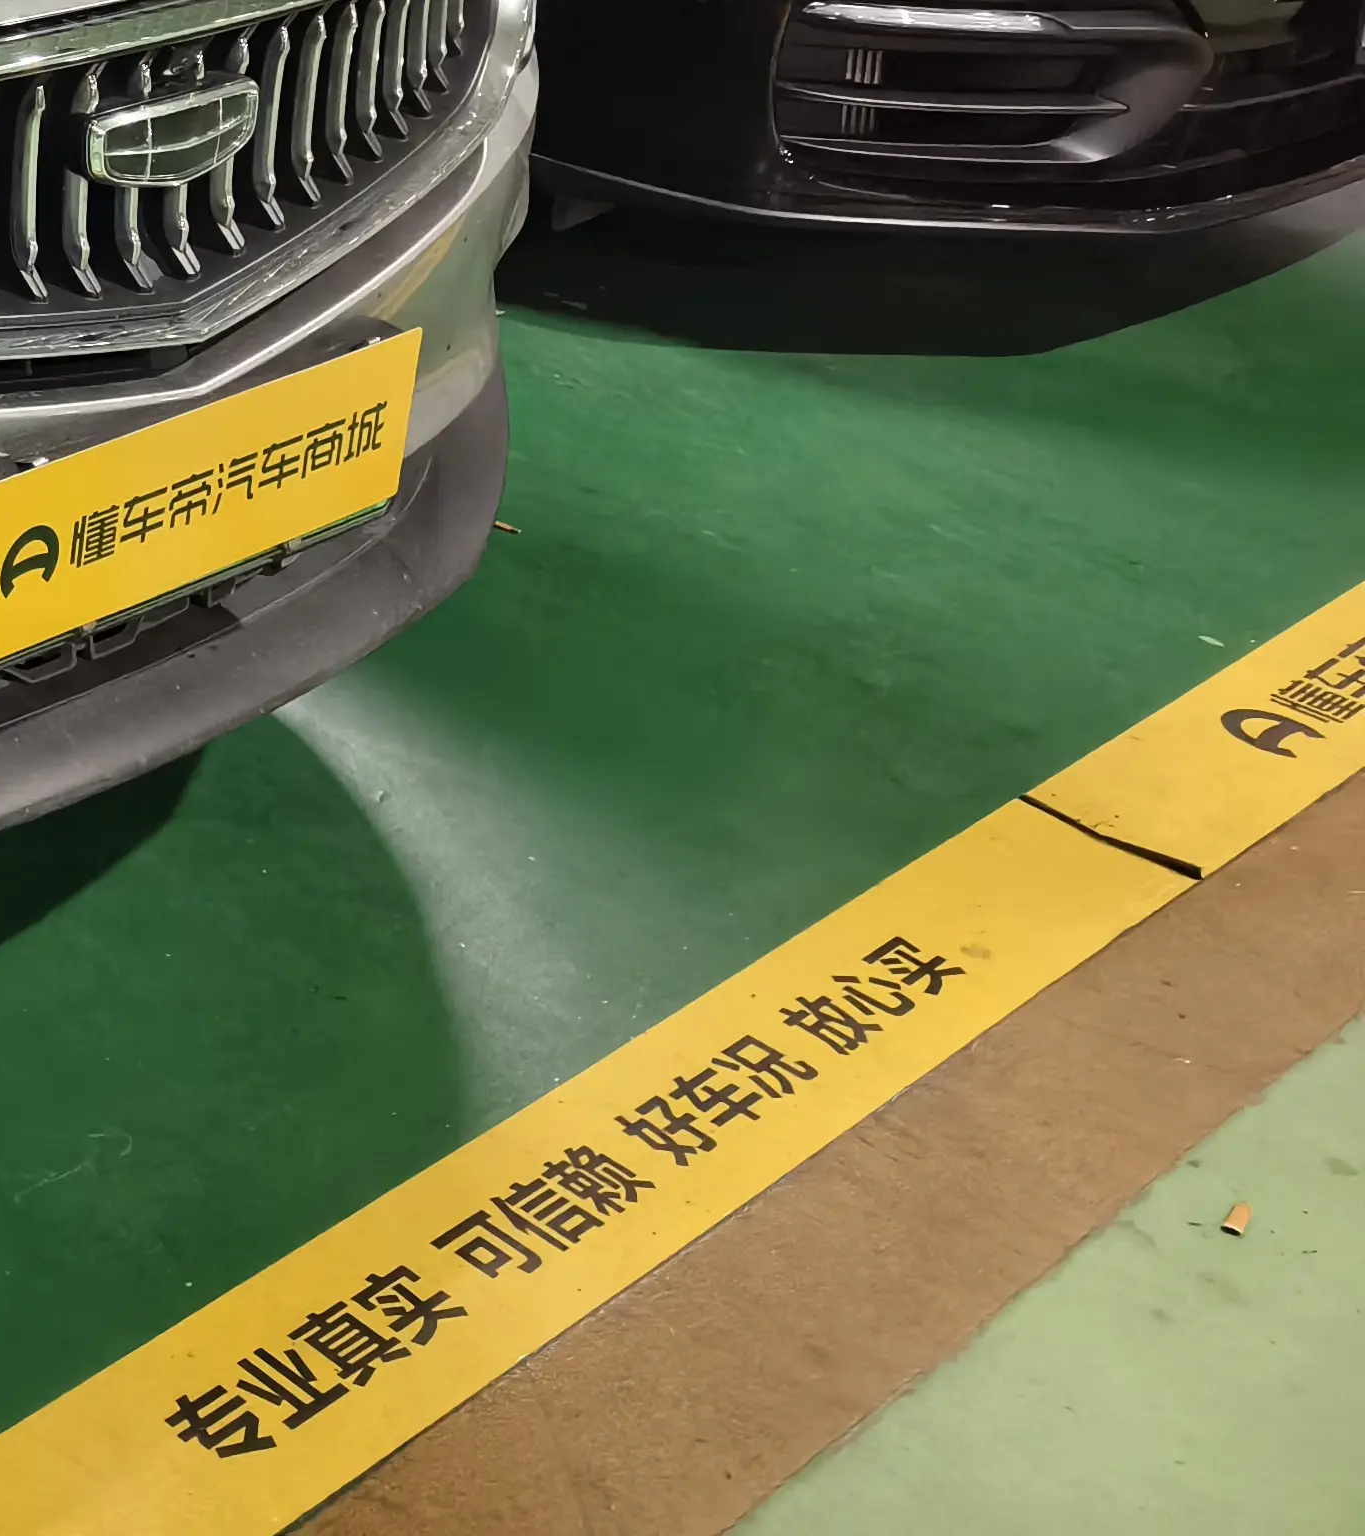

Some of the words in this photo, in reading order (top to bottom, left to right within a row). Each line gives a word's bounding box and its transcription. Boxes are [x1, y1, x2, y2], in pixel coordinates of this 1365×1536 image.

[69, 400, 388, 568] 懂车帝汽车商城
[164, 1264, 468, 1460] 专业真实
[430, 1145, 657, 1280] 可信赖
[615, 1034, 818, 1167] 好车况
[780, 936, 966, 1056] 放心买
